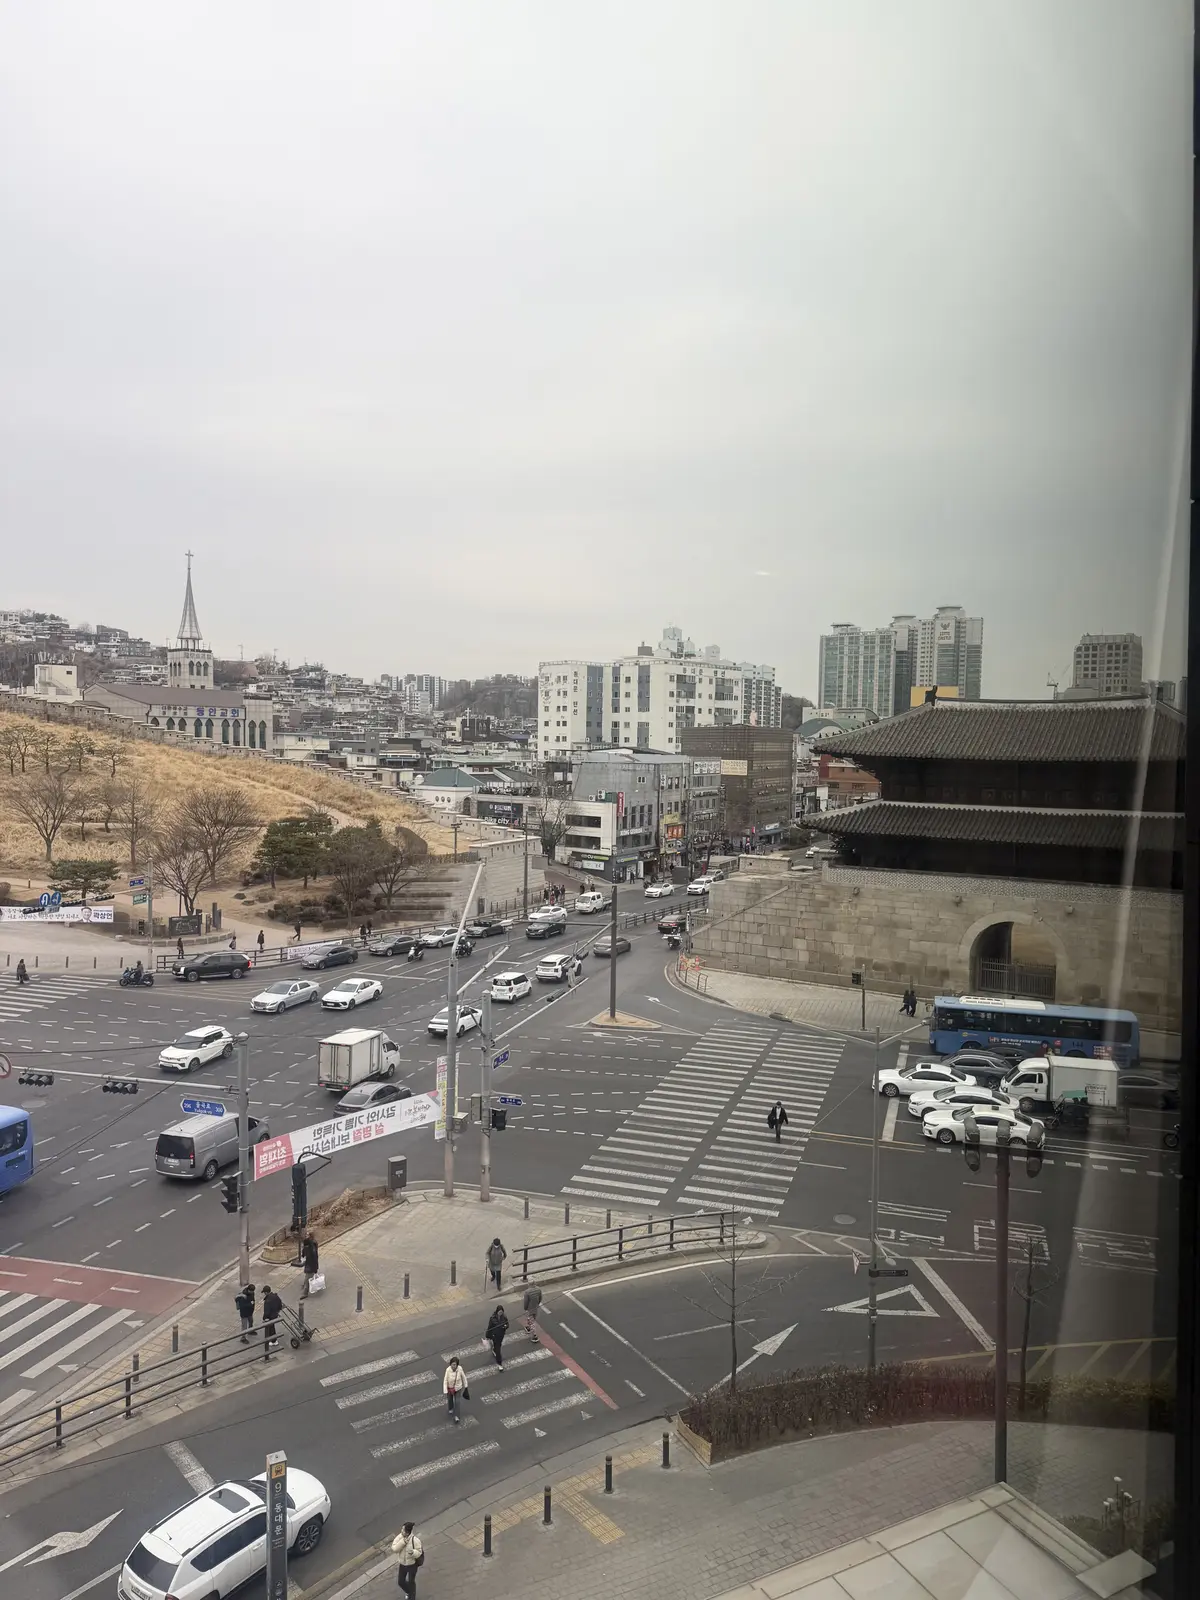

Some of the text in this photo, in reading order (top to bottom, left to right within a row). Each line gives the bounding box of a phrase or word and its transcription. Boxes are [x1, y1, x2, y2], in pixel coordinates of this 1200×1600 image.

[497, 817, 510, 825] city
[274, 1482, 282, 1493] 9
[274, 1503, 283, 1535] 동대문
